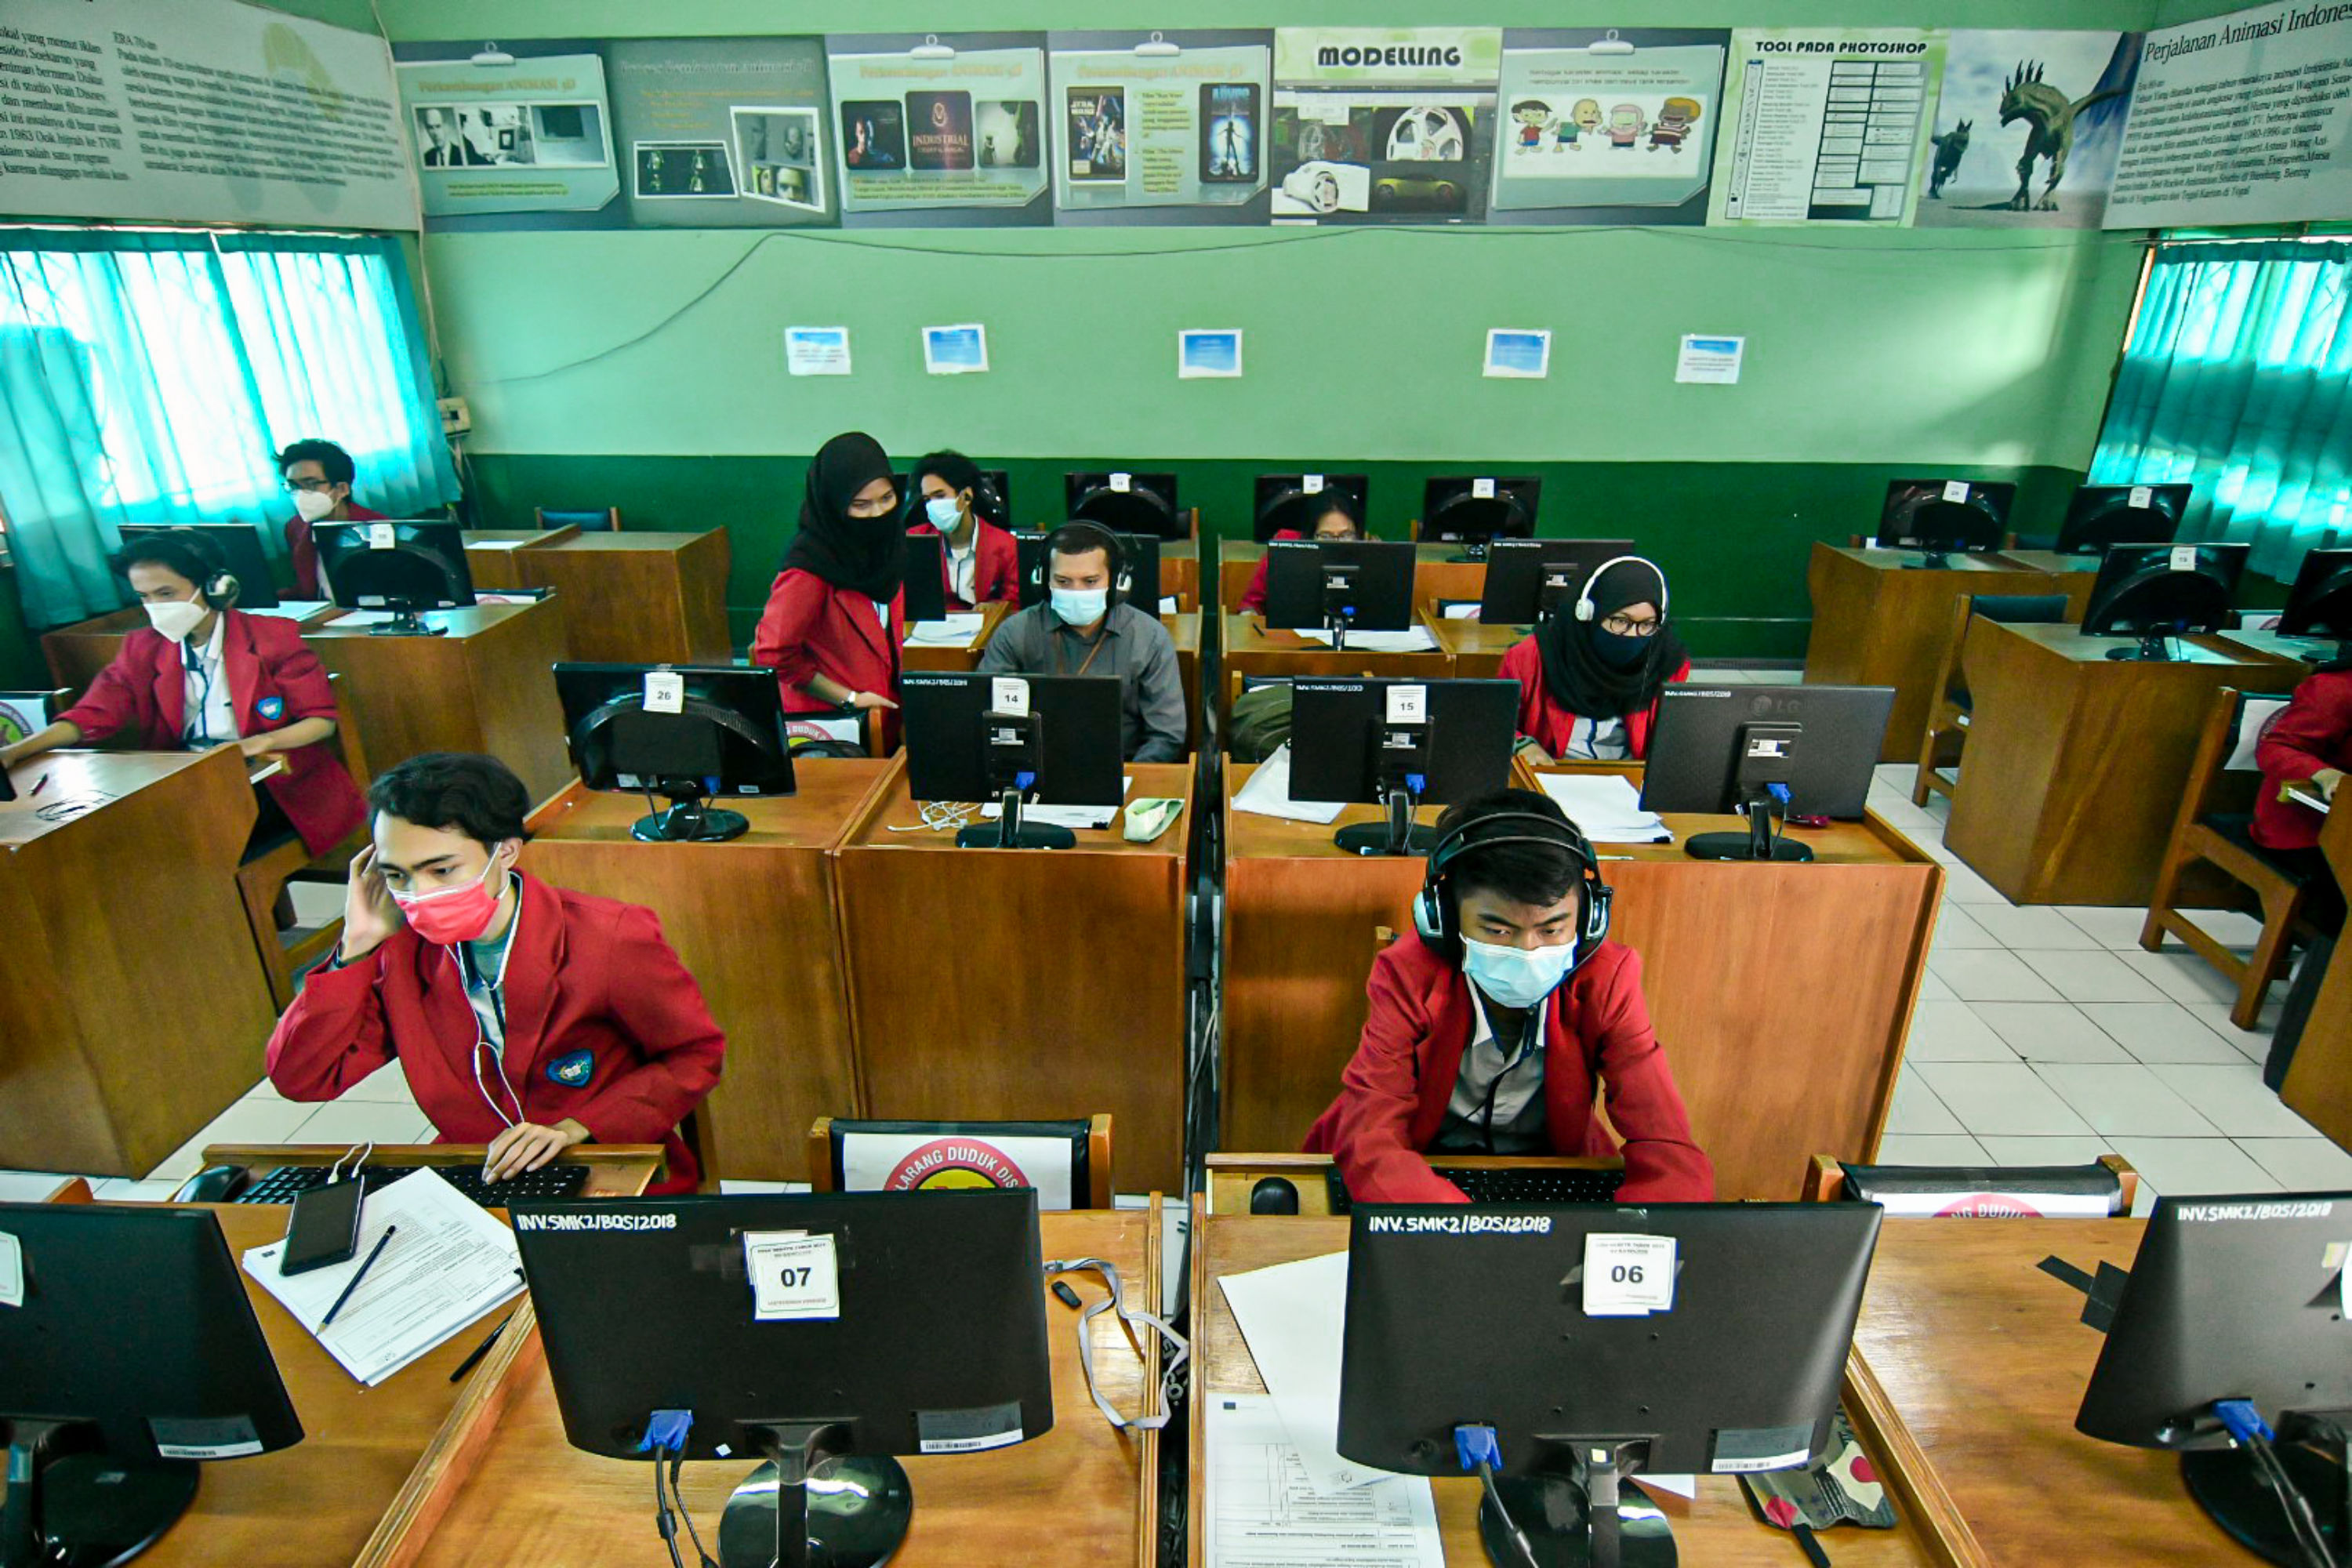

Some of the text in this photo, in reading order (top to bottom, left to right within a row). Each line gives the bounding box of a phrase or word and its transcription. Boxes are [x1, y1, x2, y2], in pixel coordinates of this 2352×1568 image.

[1756, 42, 1927, 53] TOOL PADA PHOTOSHOP
[2144, 33, 2216, 64] Perjalanan
[2220, 13, 2285, 46] Animasi
[1318, 46, 1461, 67] MODELLING
[658, 690, 672, 700] 26
[947, 1146, 998, 1169] DUDUK
[2178, 1202, 2332, 1221] INV.SMK2/BOS/2018
[1369, 1215, 1552, 1233] INV.SMK2/BOS/2018
[781, 1267, 811, 1287] 07
[1611, 1265, 1643, 1283] 06
